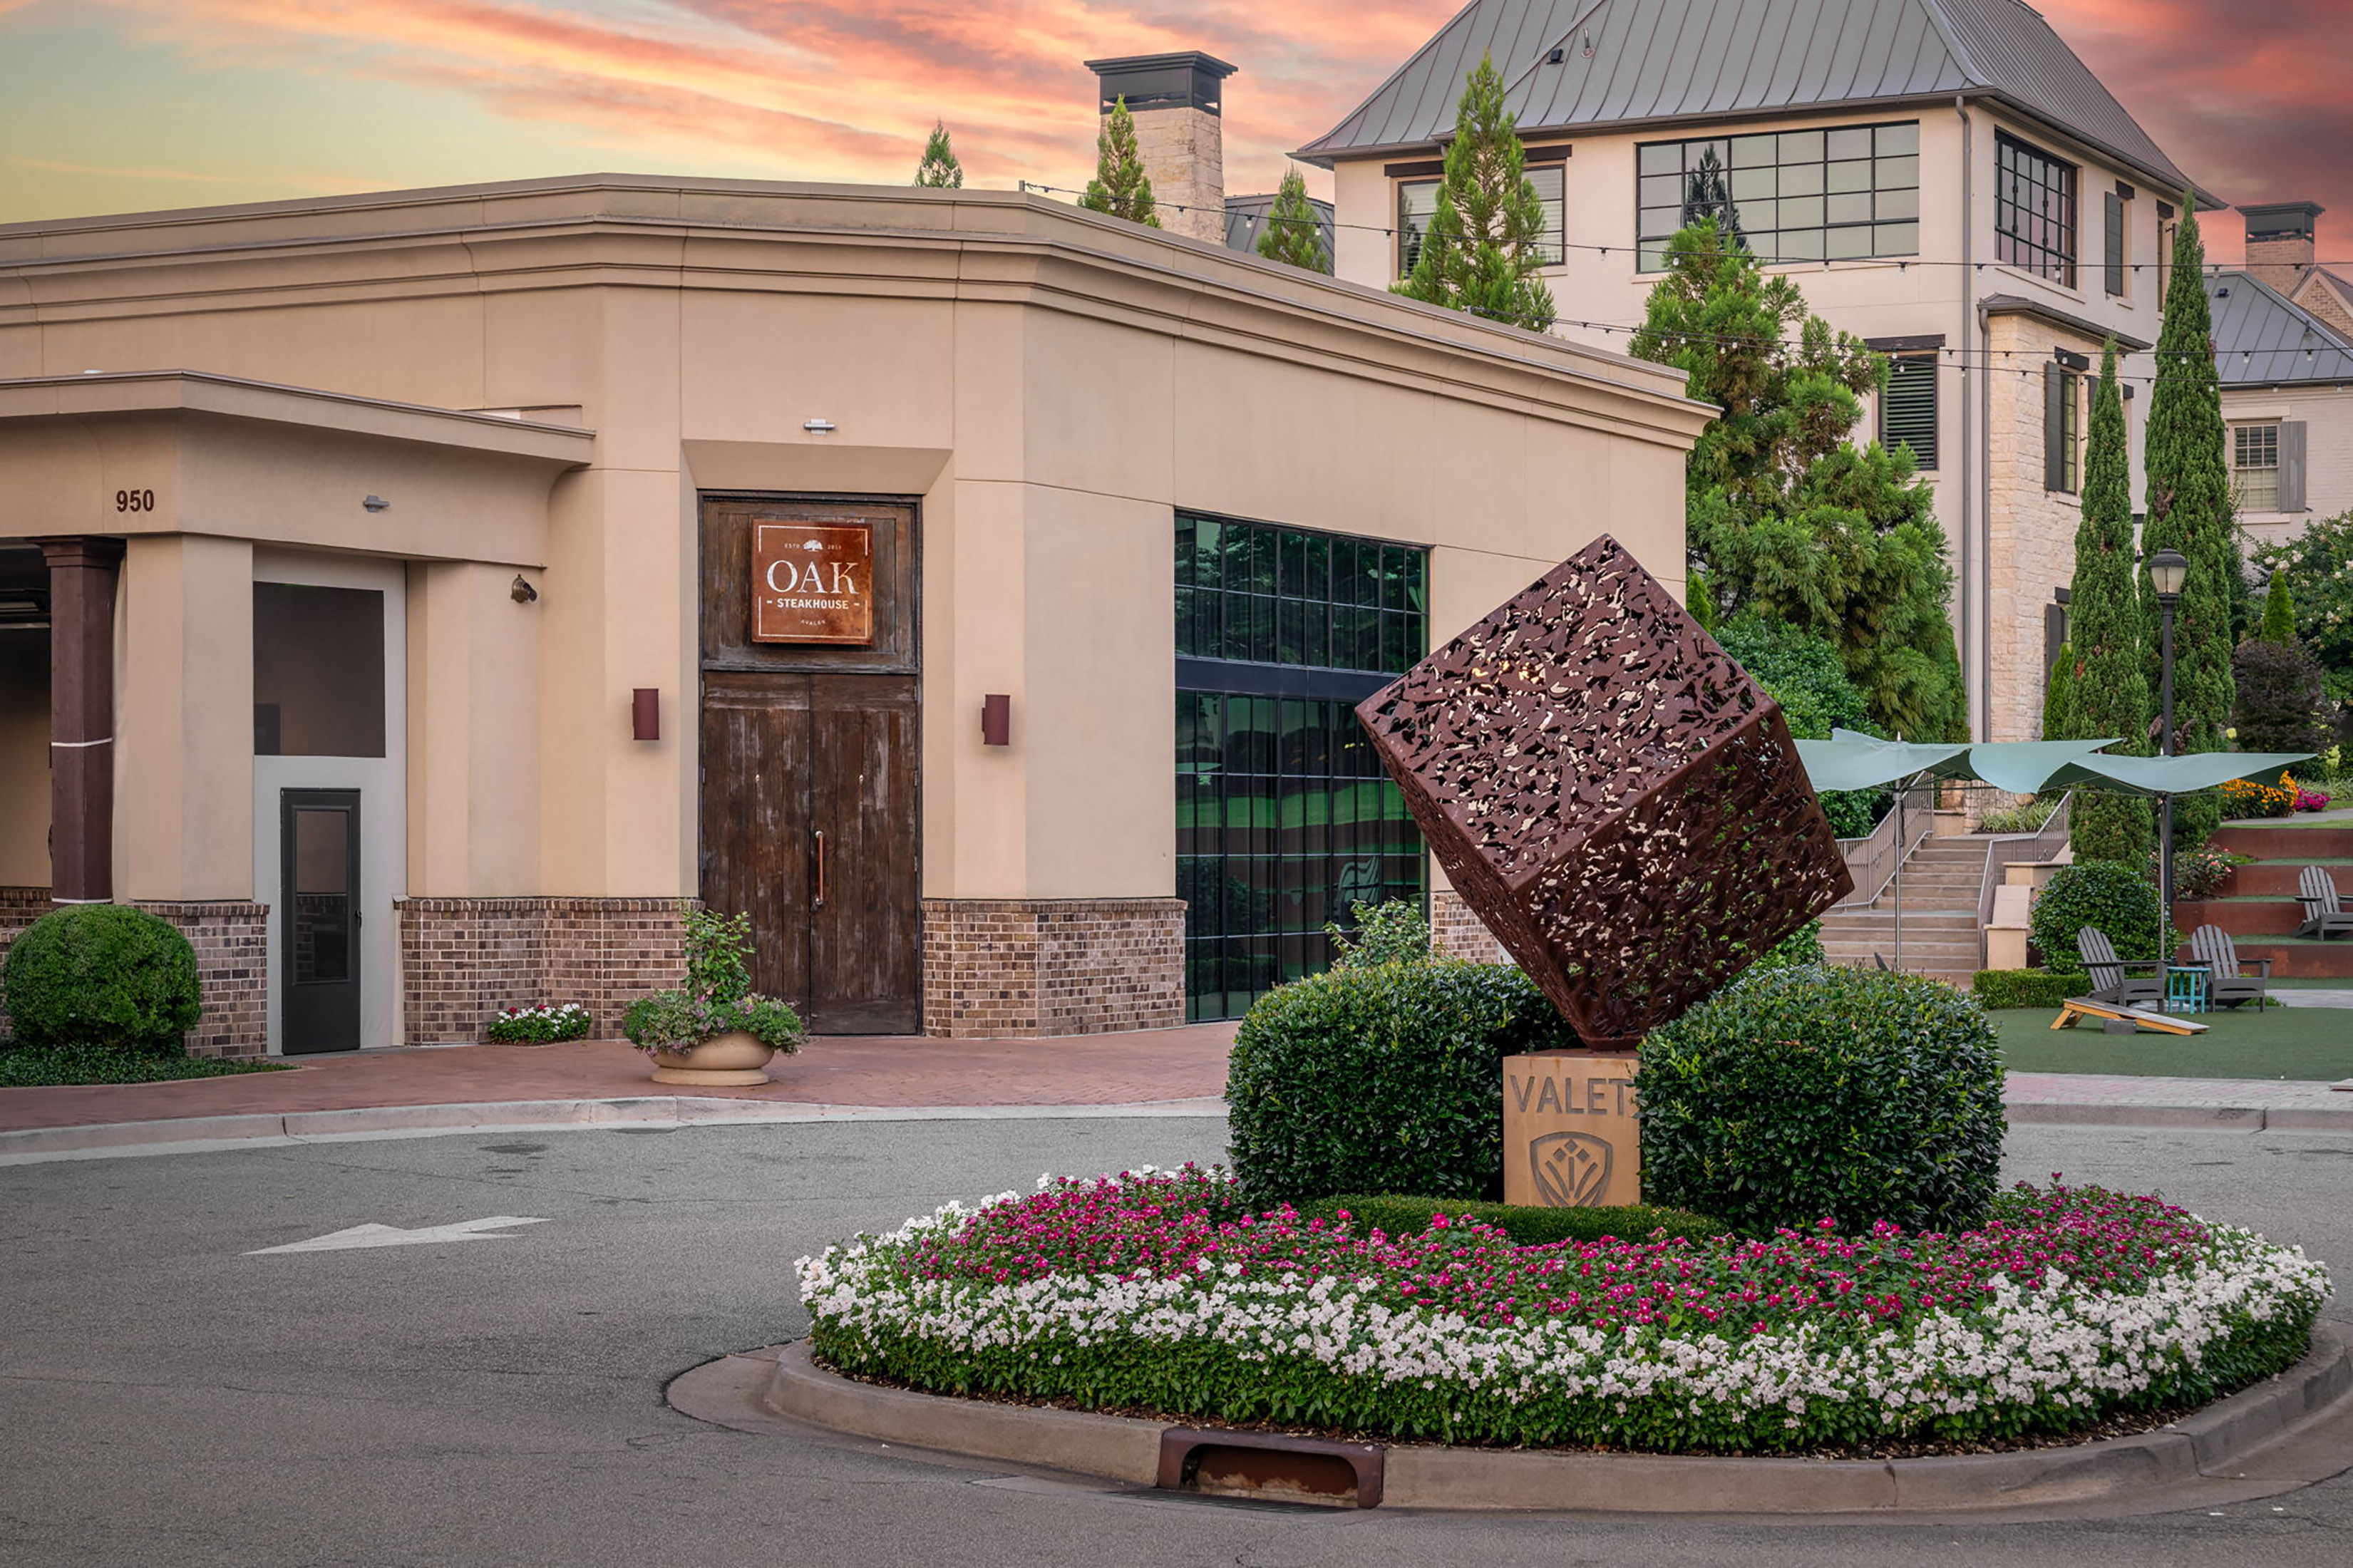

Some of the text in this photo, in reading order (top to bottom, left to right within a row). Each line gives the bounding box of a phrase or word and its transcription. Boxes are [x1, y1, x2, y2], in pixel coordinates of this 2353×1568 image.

[116, 489, 155, 512] 950
[766, 559, 859, 594] OAK
[777, 598, 849, 609] STEAKHOUSE
[1509, 1074, 1632, 1115] VALET
